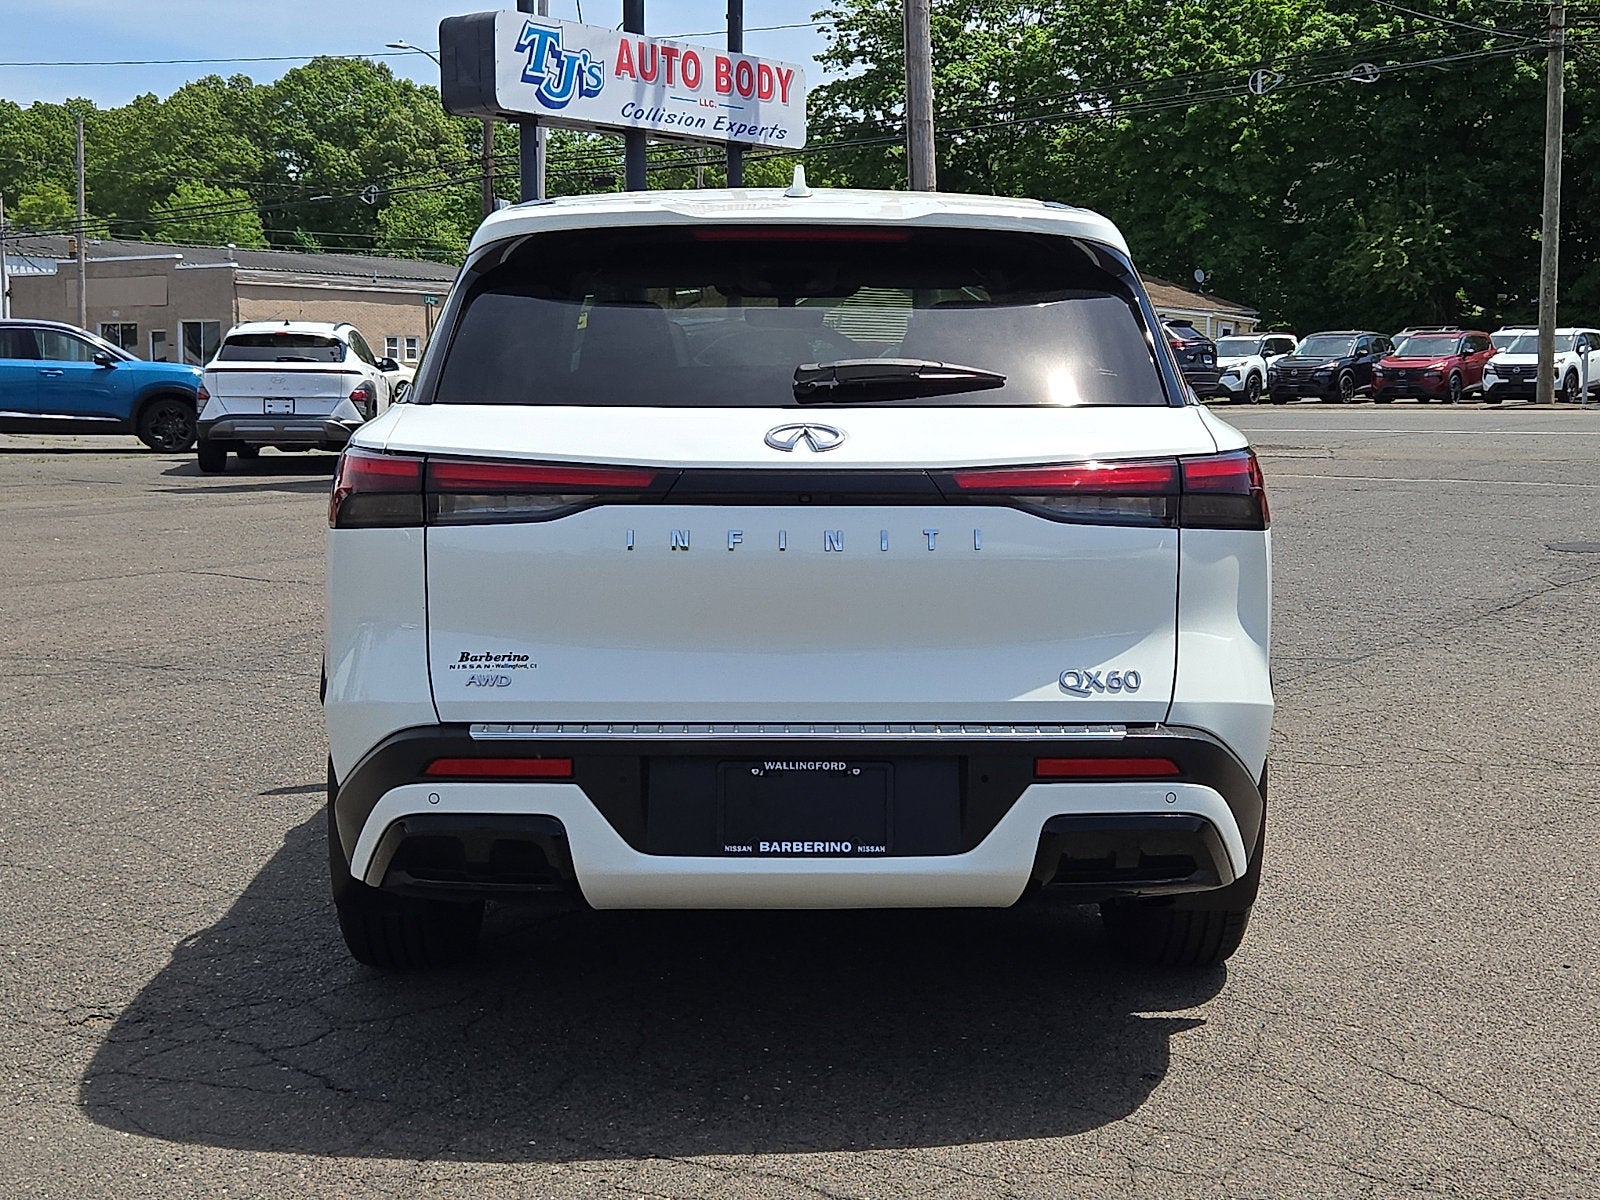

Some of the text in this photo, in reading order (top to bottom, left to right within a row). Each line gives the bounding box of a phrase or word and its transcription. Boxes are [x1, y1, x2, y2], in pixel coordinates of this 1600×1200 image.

[514, 19, 795, 110] TJ's AUTO BODY
[699, 98, 717, 109] LLC.
[621, 102, 788, 140] Collision Experts
[626, 529, 982, 551] INFINITI
[458, 651, 530, 662] Barberino
[465, 673, 512, 687] AWD
[1059, 669, 1142, 697] QX60
[764, 761, 847, 771] WALLINGFORD
[724, 841, 886, 853] NISSAN BARBERINO NISSAN
